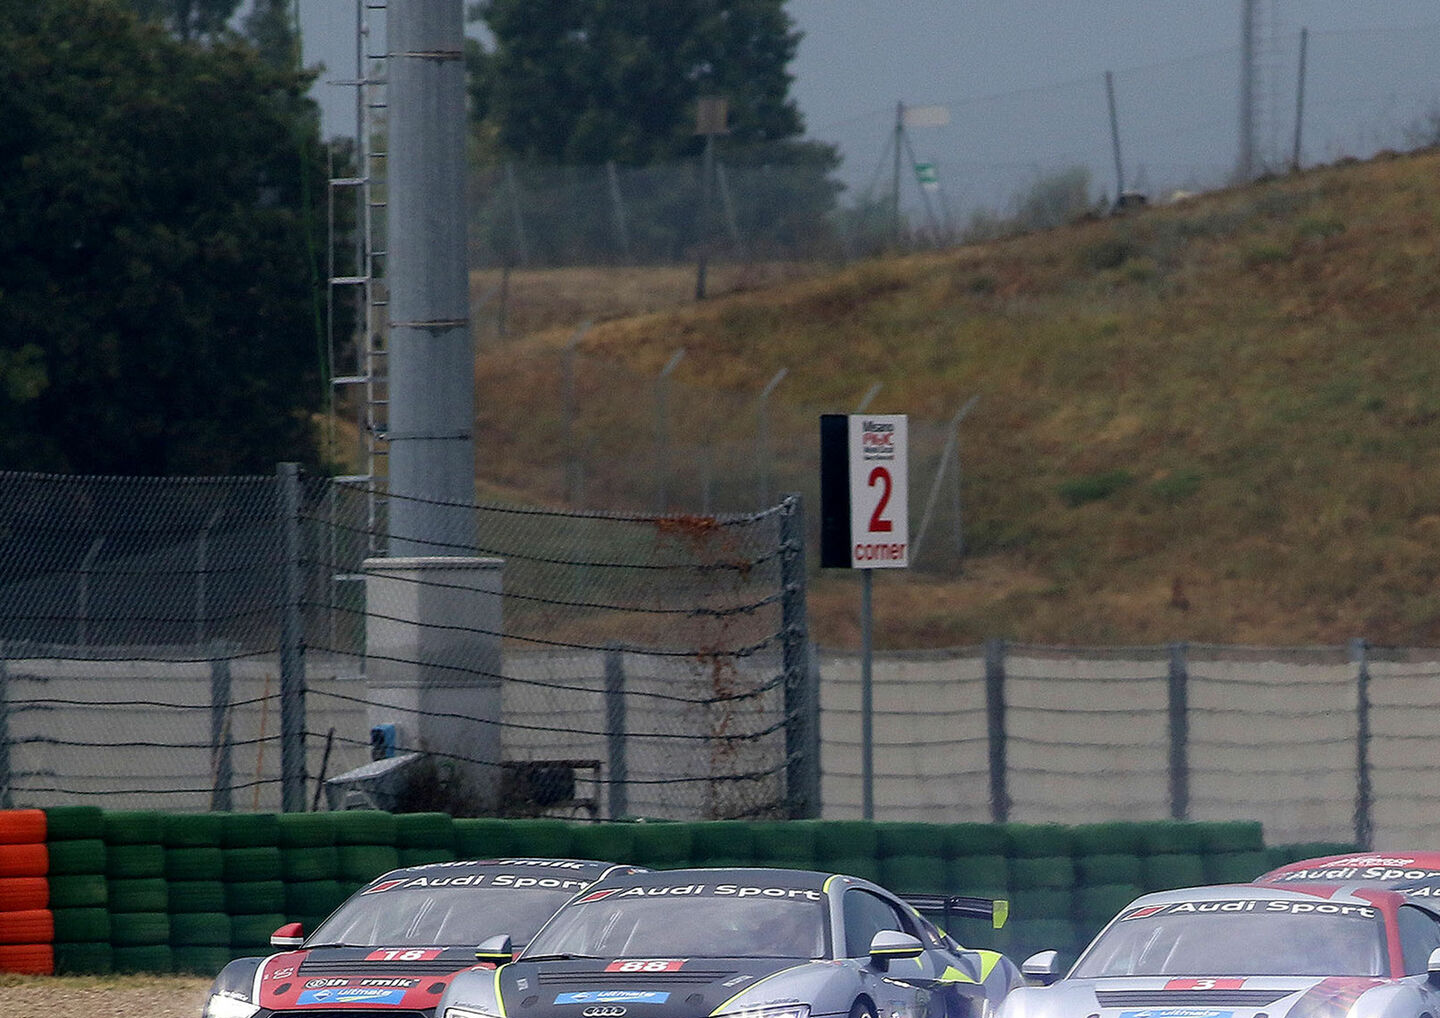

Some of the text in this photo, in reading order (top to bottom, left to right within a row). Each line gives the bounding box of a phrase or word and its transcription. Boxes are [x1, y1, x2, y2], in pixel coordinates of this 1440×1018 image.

[868, 466, 892, 532] 2
[855, 544, 906, 560] corner
[1285, 868, 1358, 879] Audi
[408, 874, 591, 890] Audi Sport
[621, 884, 821, 900] Audi Sport
[1169, 900, 1376, 919] Audi Sport
[384, 950, 426, 961] 18
[620, 960, 670, 972] 88
[1198, 978, 1217, 990] 3
[336, 988, 393, 996] ultimate
[596, 990, 656, 999] ultimate
